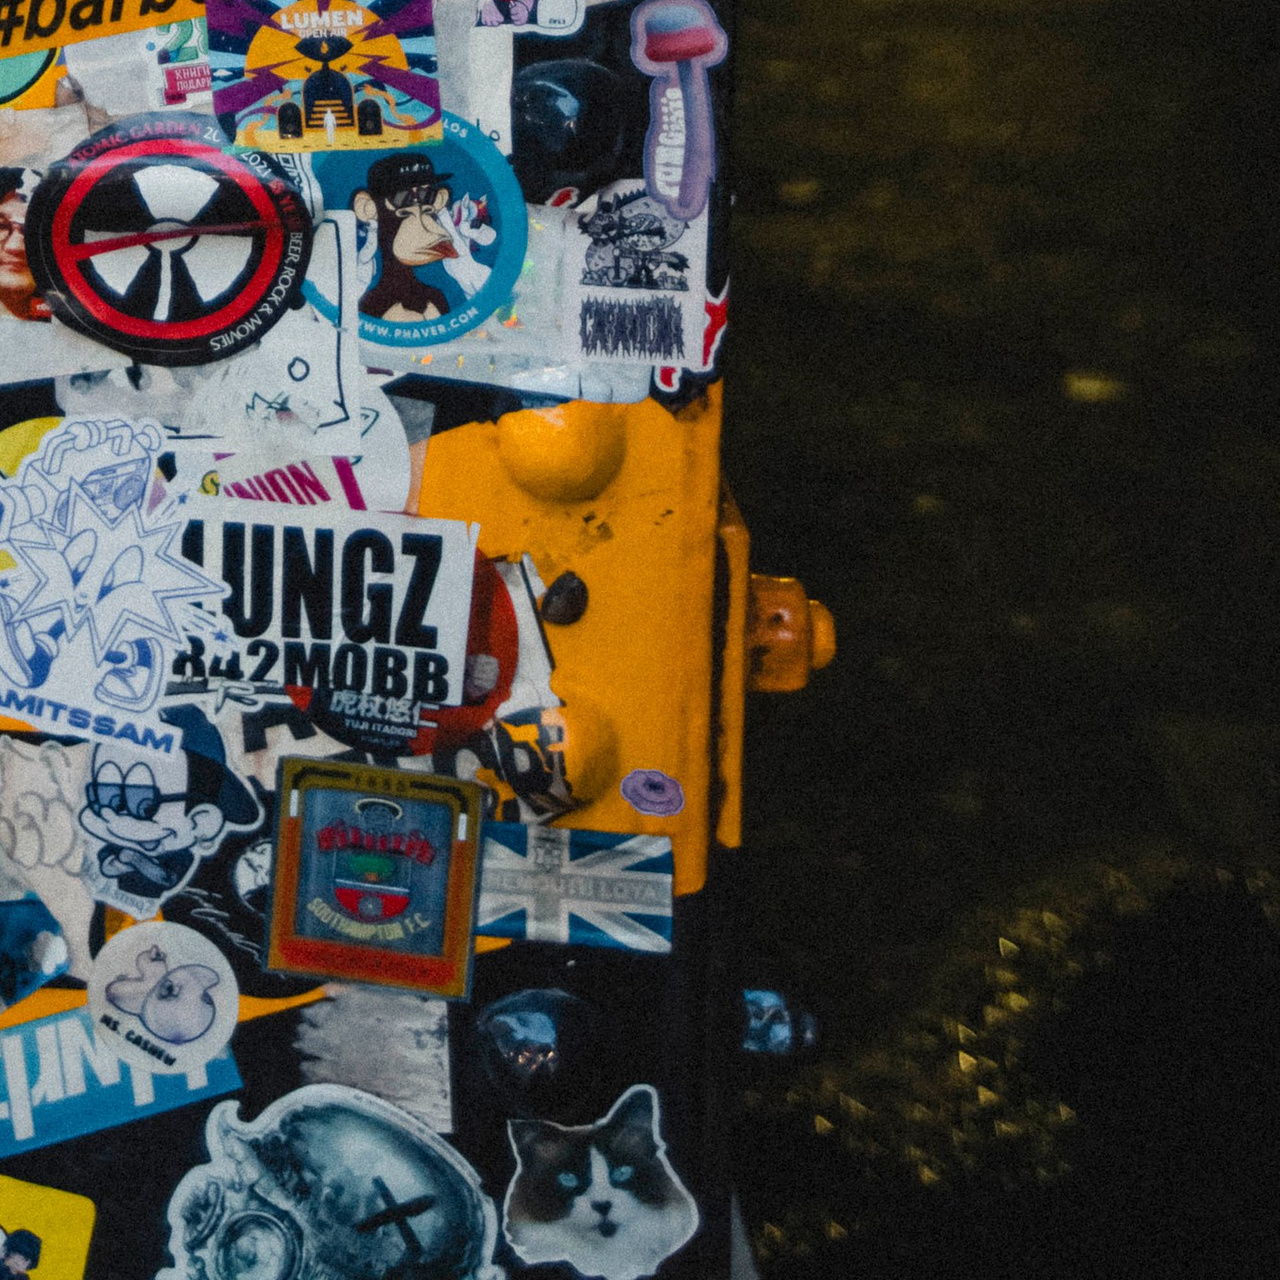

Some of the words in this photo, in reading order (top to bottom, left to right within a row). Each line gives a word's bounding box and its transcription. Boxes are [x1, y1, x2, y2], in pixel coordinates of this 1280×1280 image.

[280, 10, 364, 30] LUMEN
[298, 28, 328, 39] OPEN
[329, 28, 348, 38] AIR
[69, 130, 129, 170] TOMIC
[267, 265, 296, 307] ROCK
[210, 313, 263, 352] MOVIES
[306, 897, 406, 941] SOUTHAMPTON
